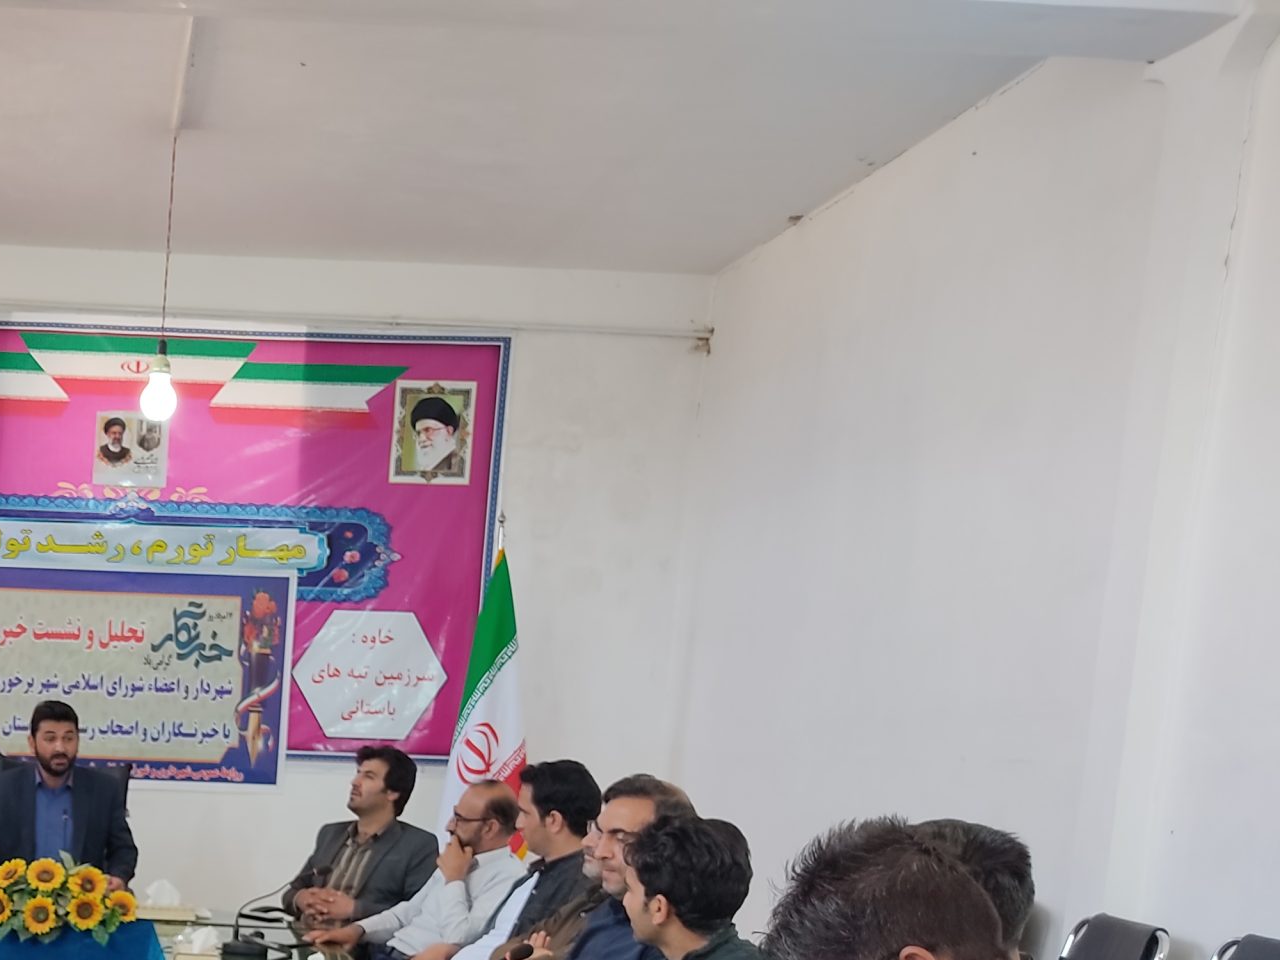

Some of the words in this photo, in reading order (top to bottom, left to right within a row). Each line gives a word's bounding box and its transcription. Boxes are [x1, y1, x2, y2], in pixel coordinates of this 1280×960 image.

[36, 530, 126, 563] رشد
[217, 534, 307, 566] مهار
[32, 618, 82, 642] نشست
[86, 631, 94, 650] و
[97, 617, 145, 650] تجلیل
[360, 628, 394, 650] خاوه
[37, 673, 59, 695] شهر
[62, 672, 104, 696] اسلامی
[311, 662, 342, 684] های
[374, 668, 435, 688] سرزمین
[106, 675, 145, 698] شورای
[182, 685, 190, 701] و
[192, 678, 233, 701] شهردار
[340, 699, 396, 721] باستانی
[97, 719, 139, 738] اصحاب
[141, 727, 148, 742] و
[150, 721, 220, 746] خبرنگاران
[221, 727, 231, 741] با
